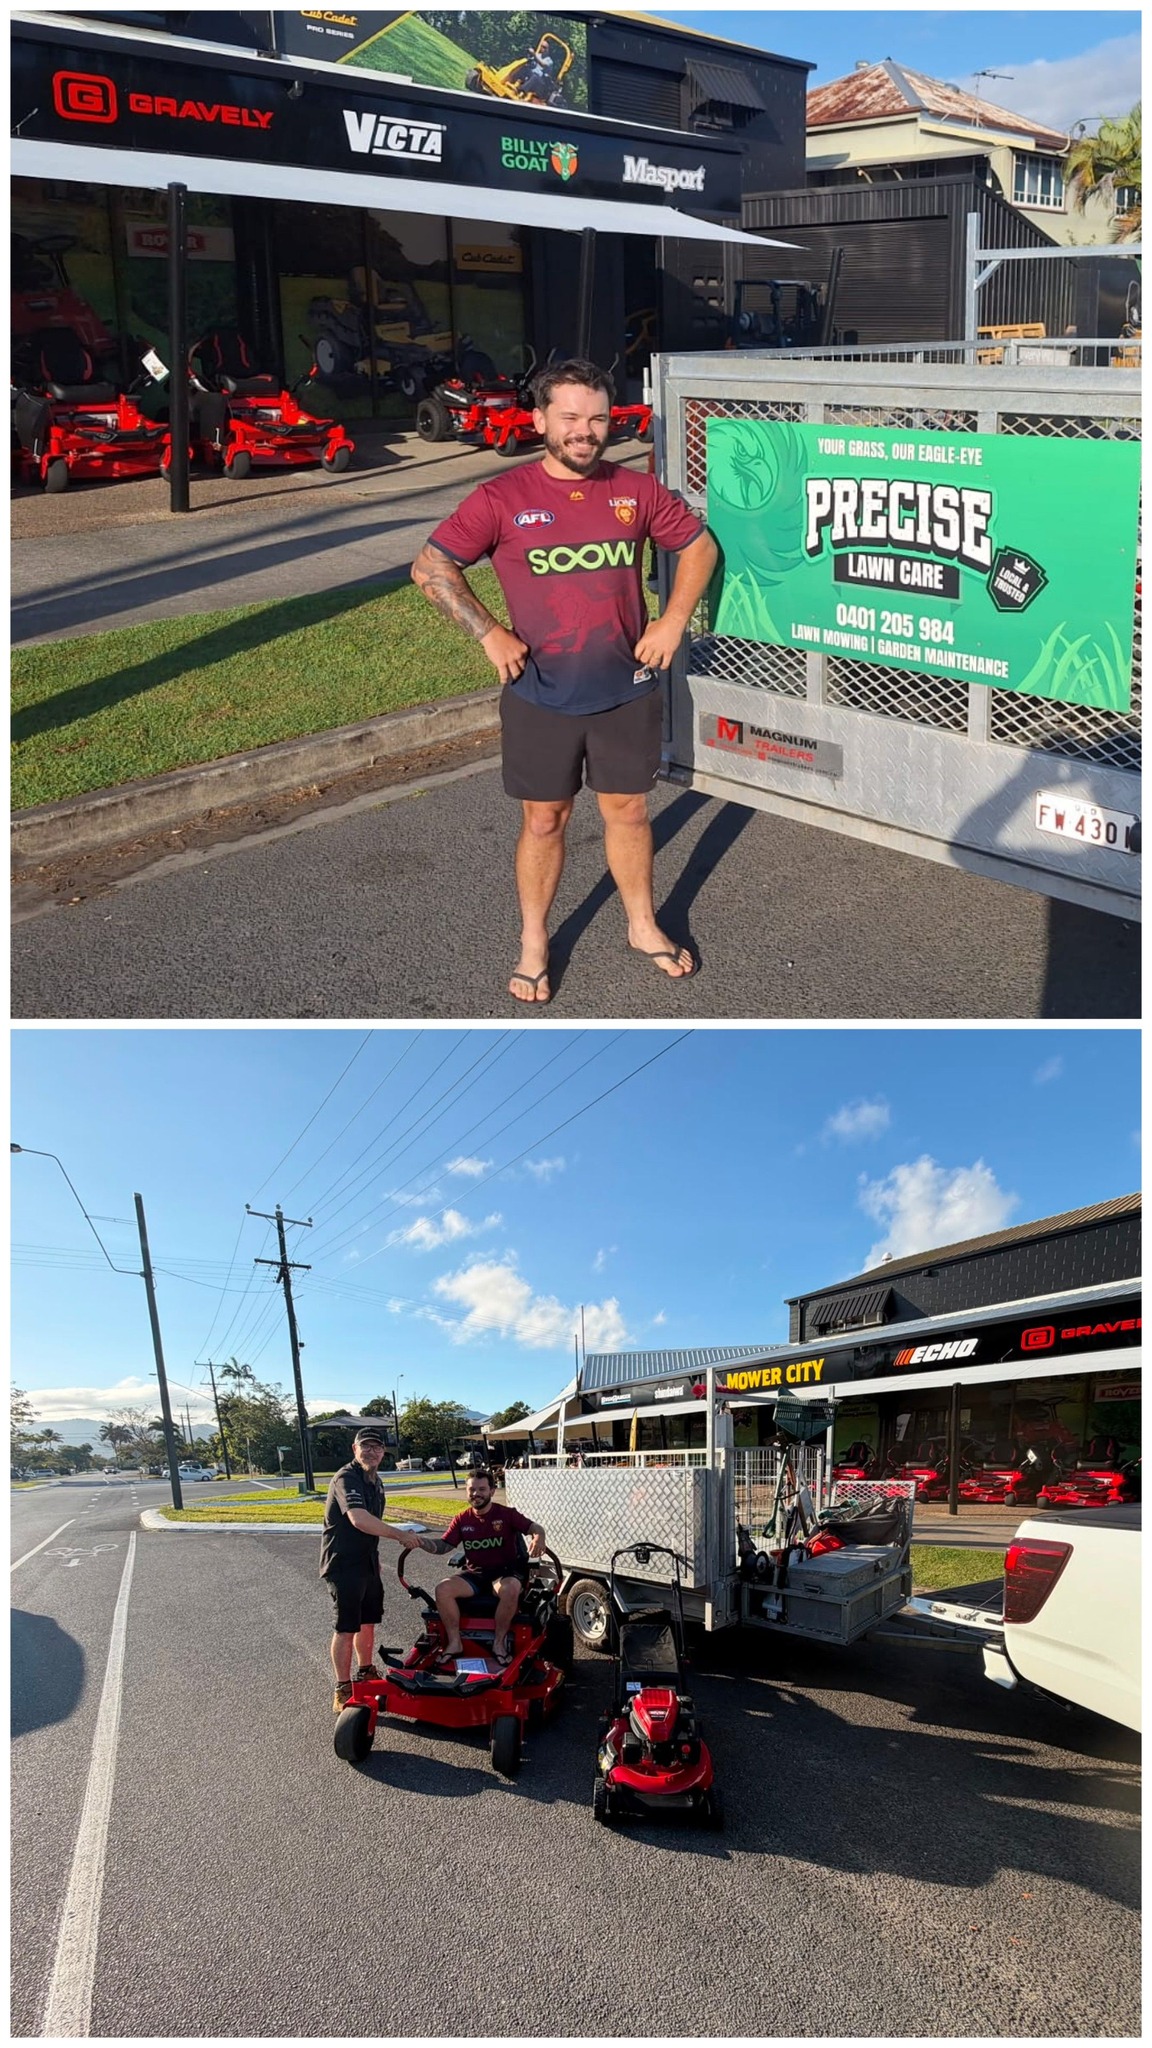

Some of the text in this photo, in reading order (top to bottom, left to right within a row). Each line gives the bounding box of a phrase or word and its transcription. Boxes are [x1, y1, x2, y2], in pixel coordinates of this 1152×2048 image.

[306, 24, 355, 39] PRO SERIES
[323, 11, 358, 26] Cadet
[129, 93, 275, 129] GRAVELY
[342, 109, 444, 156] VICTA
[501, 137, 548, 156] BILLY
[501, 154, 548, 172] GOAT
[623, 155, 705, 192] Masport
[141, 233, 199, 250] ROR
[818, 438, 983, 465] YOUR GRASS, OUR EAGLE-EYE
[520, 512, 551, 525] AFL
[806, 479, 992, 569] PRECISE
[848, 554, 944, 590] LAWN CARE
[999, 567, 1022, 589] LOCAL
[994, 577, 1026, 603] TRUSTED
[836, 603, 955, 645] 0401 205 984
[791, 623, 821, 643] LAWN
[823, 628, 868, 651] MOWING
[878, 639, 921, 662] GARDEN
[924, 647, 1009, 678] MAINTENANCE
[749, 726, 818, 750] MAGNUM
[755, 740, 815, 762] TRAILERS
[726, 1358, 825, 1390] MOWER CITY
